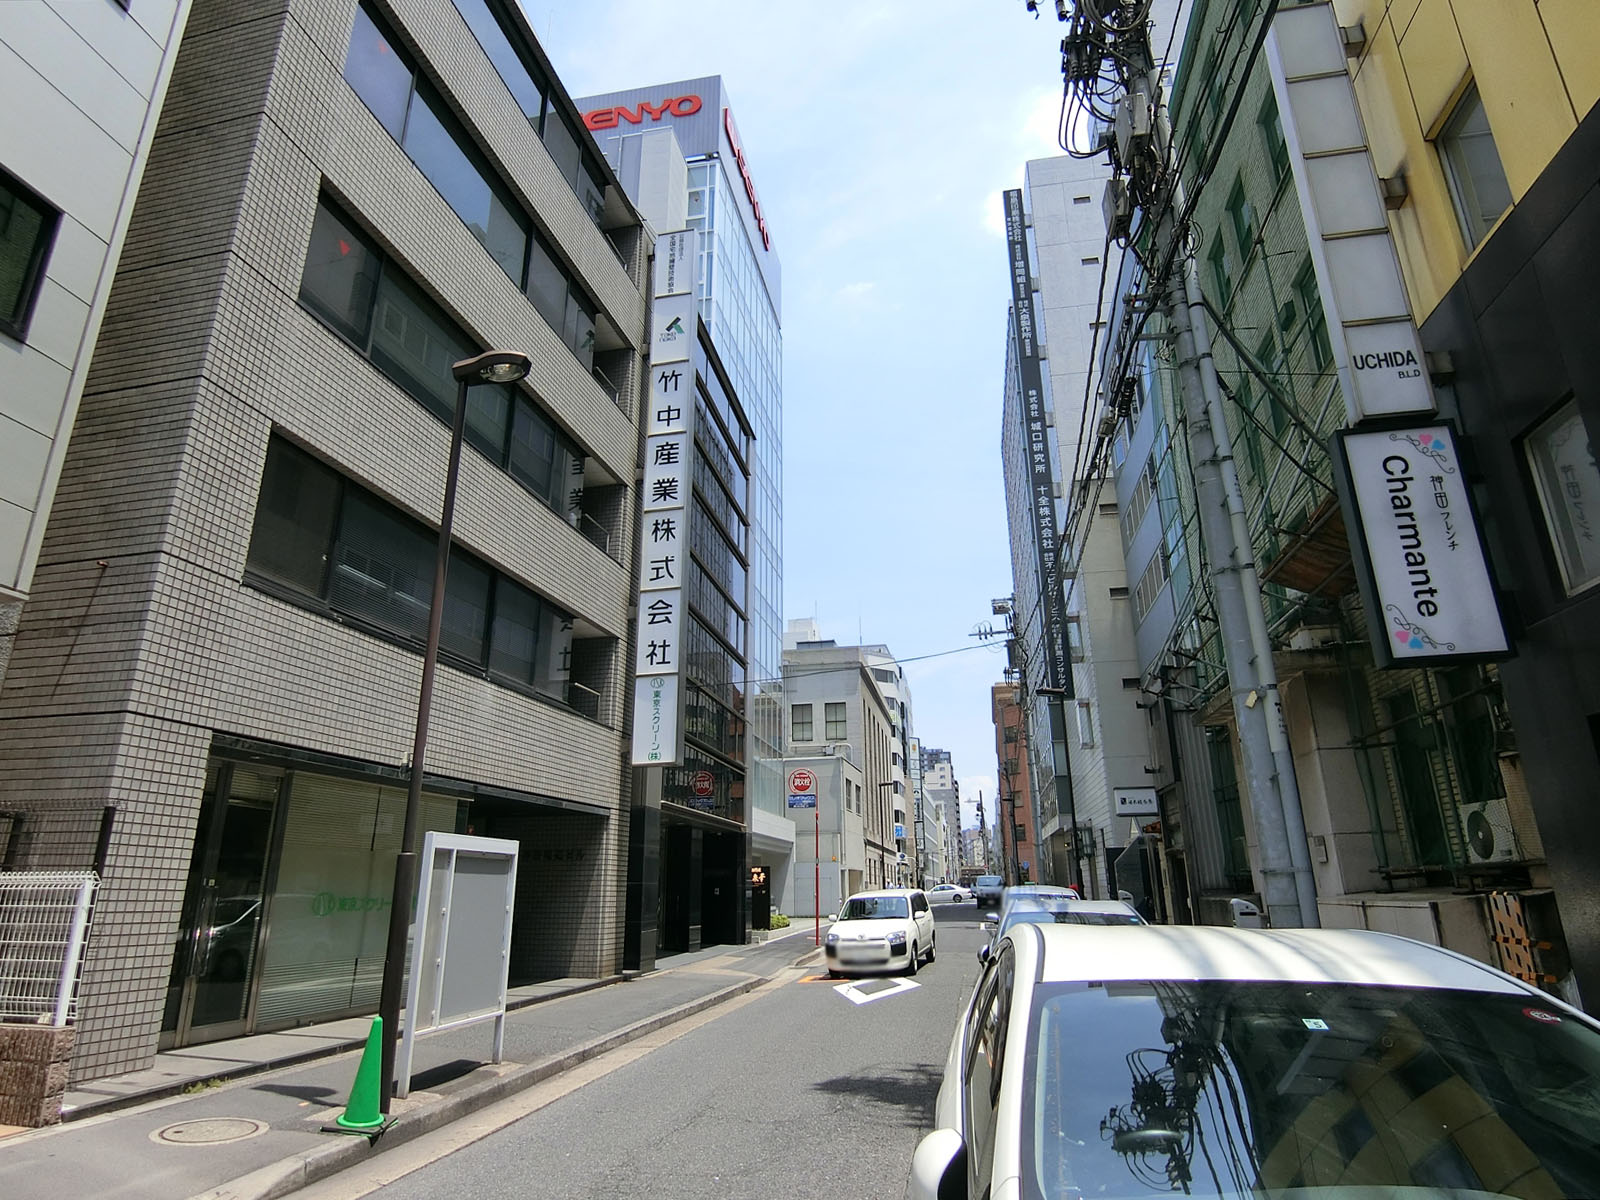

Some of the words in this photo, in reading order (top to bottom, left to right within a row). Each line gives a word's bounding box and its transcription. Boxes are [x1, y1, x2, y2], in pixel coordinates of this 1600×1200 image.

[580, 94, 703, 132] ENYO
[1352, 349, 1419, 371] UCHIDA
[1030, 421, 1047, 474] 城口研究所
[645, 369, 683, 667] 竹中産業株式会社
[1036, 485, 1054, 550] 十全株式会社
[1382, 454, 1439, 618] Charmante
